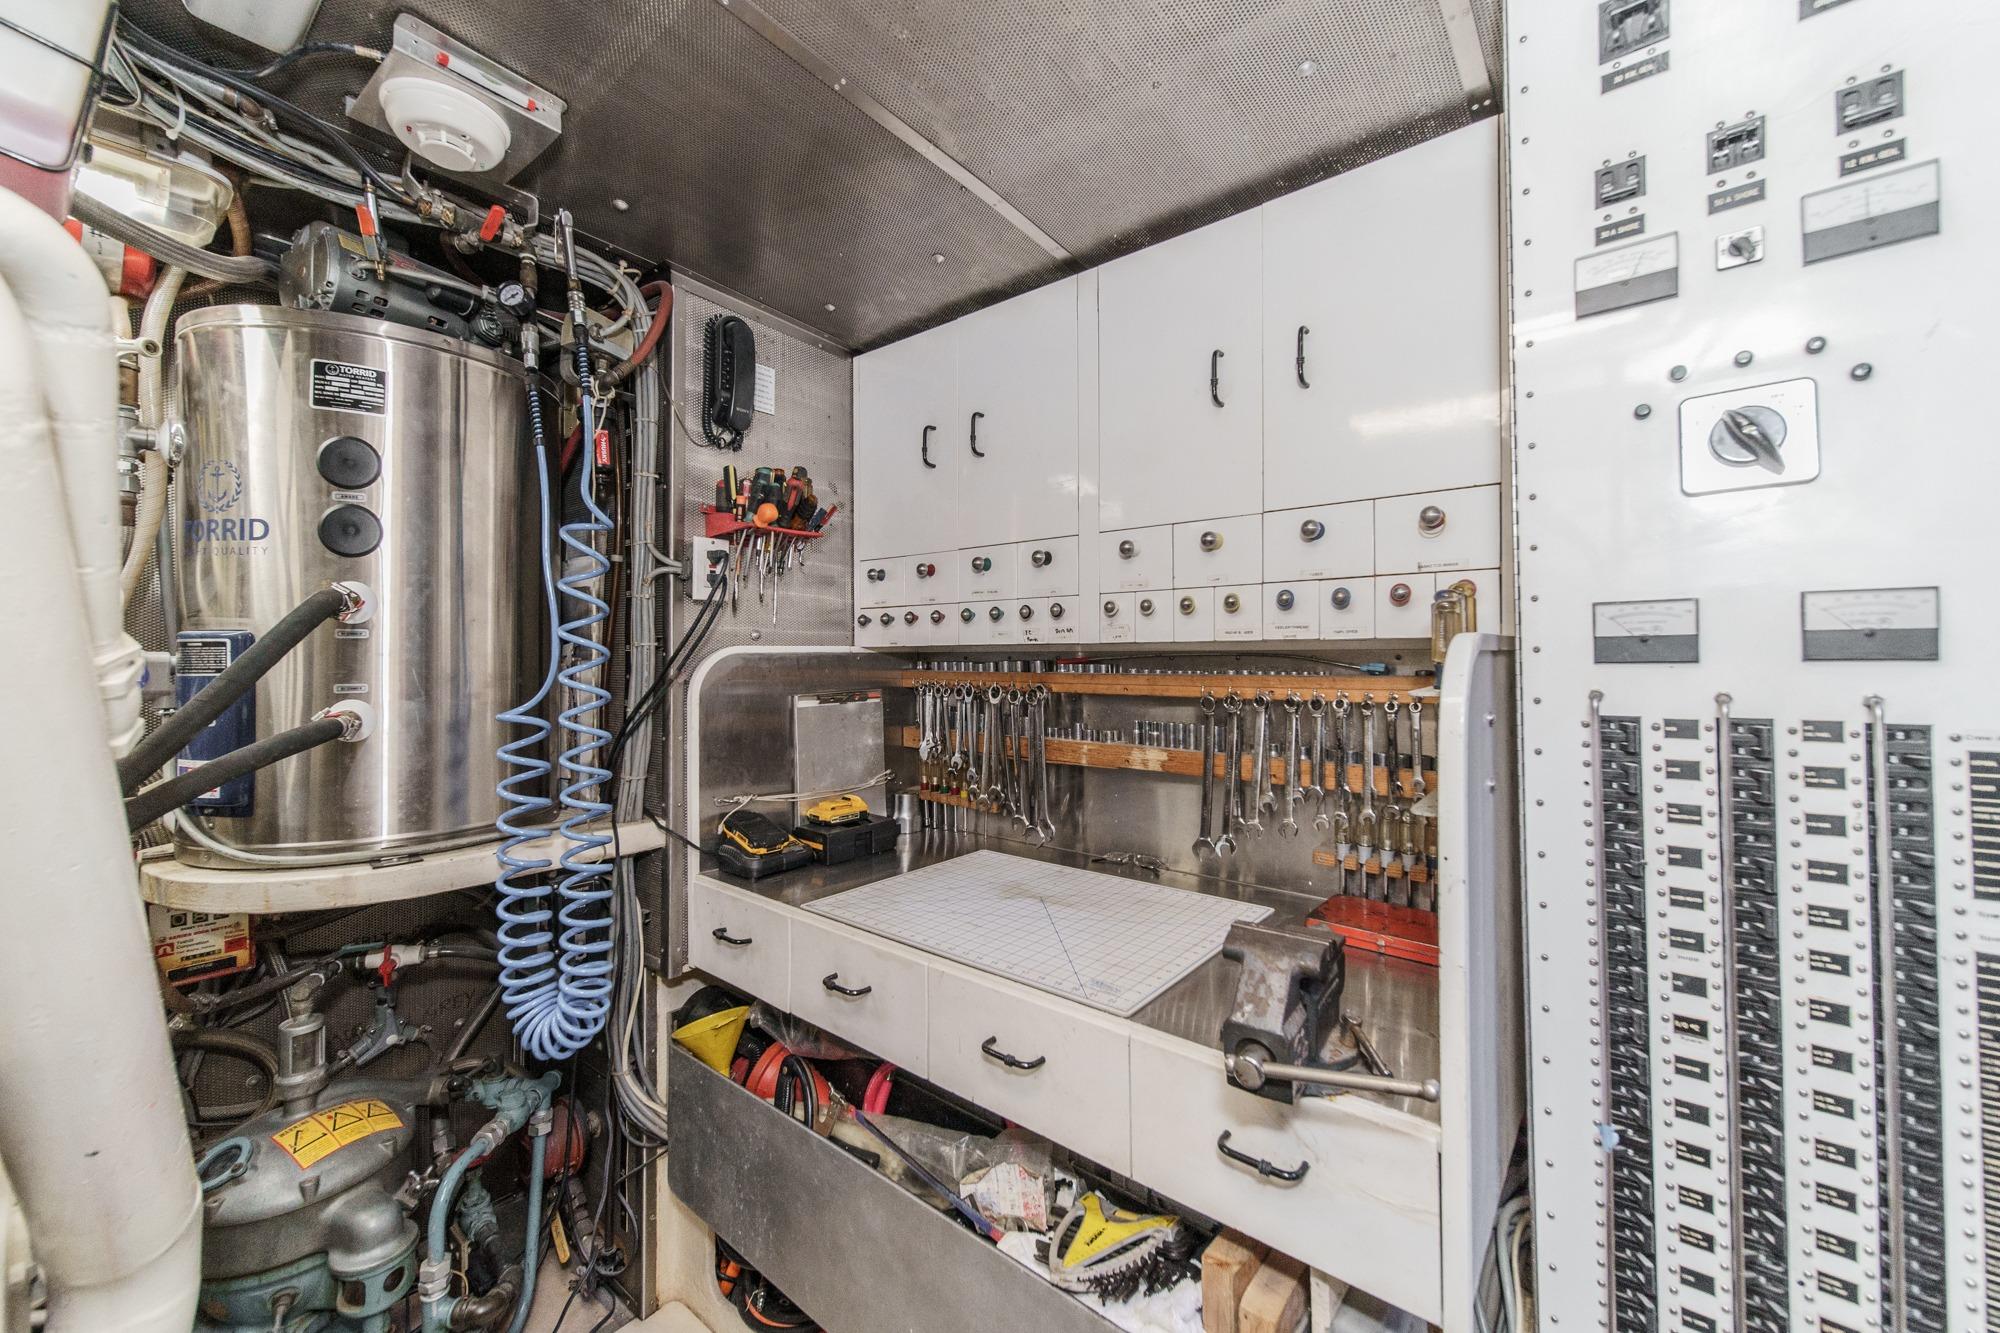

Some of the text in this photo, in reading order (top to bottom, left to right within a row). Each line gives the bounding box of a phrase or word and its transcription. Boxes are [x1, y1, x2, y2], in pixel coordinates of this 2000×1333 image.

[339, 365, 377, 378] TORRID
[184, 518, 270, 542] TORRID
[214, 546, 269, 556] QUALITY
